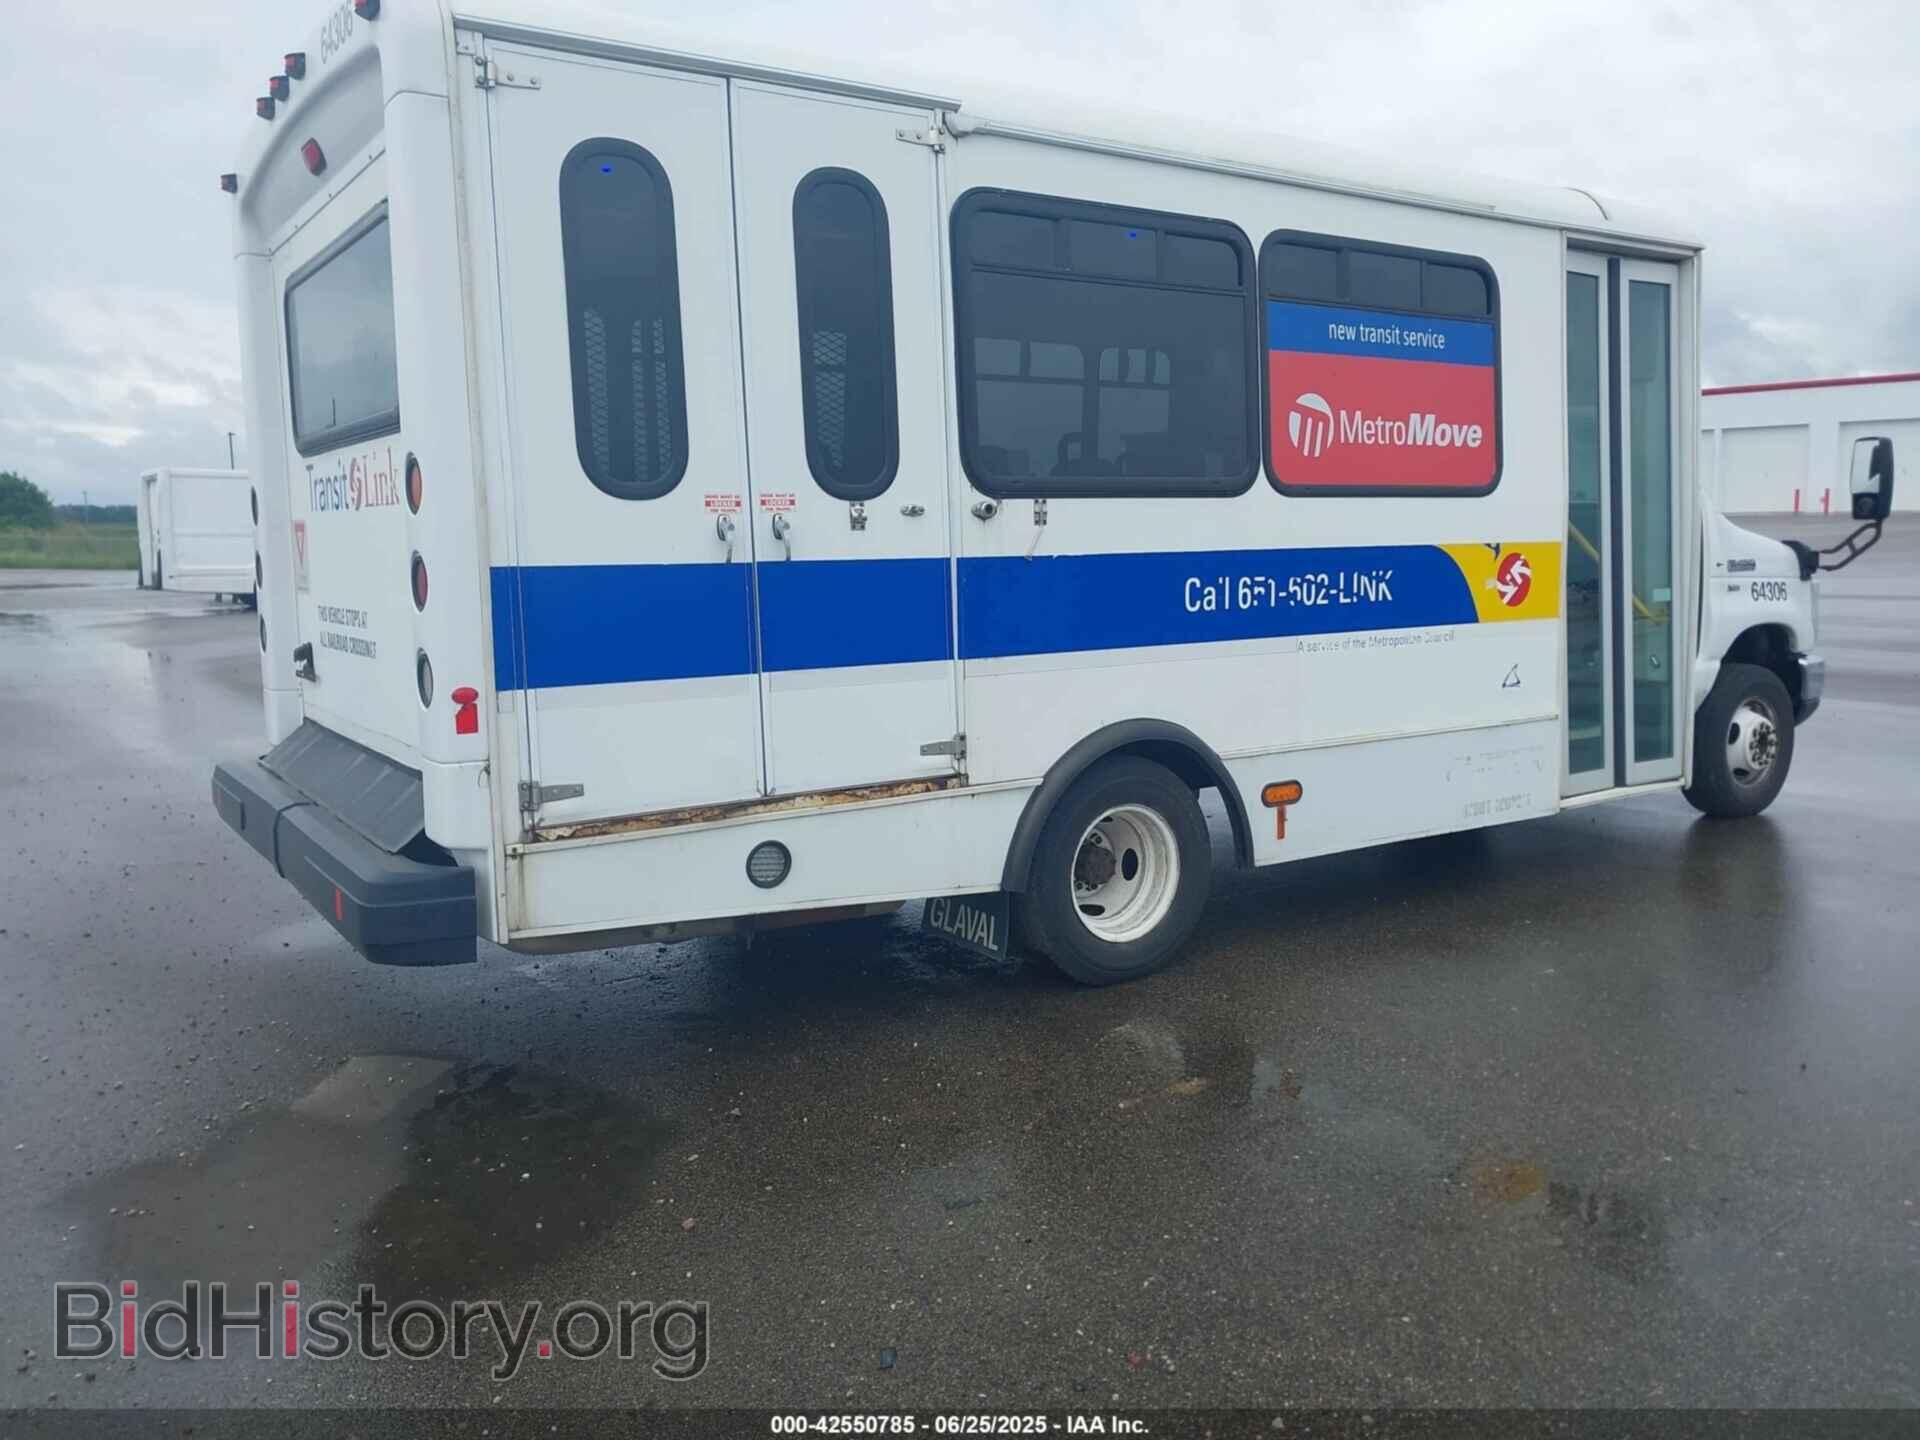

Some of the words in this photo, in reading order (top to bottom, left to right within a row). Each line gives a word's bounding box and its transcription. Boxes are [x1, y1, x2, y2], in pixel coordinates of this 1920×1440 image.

[1328, 323, 1356, 341] new
[1359, 323, 1401, 345] transit
[1403, 328, 1446, 349] service
[1339, 410, 1483, 448] MetroMove
[305, 456, 349, 512] Transit
[362, 445, 400, 507] Link
[1184, 576, 1230, 612] Cal
[1751, 581, 1787, 602] 64306
[1298, 639, 1304, 651] A
[930, 898, 999, 951] GLAVAL
